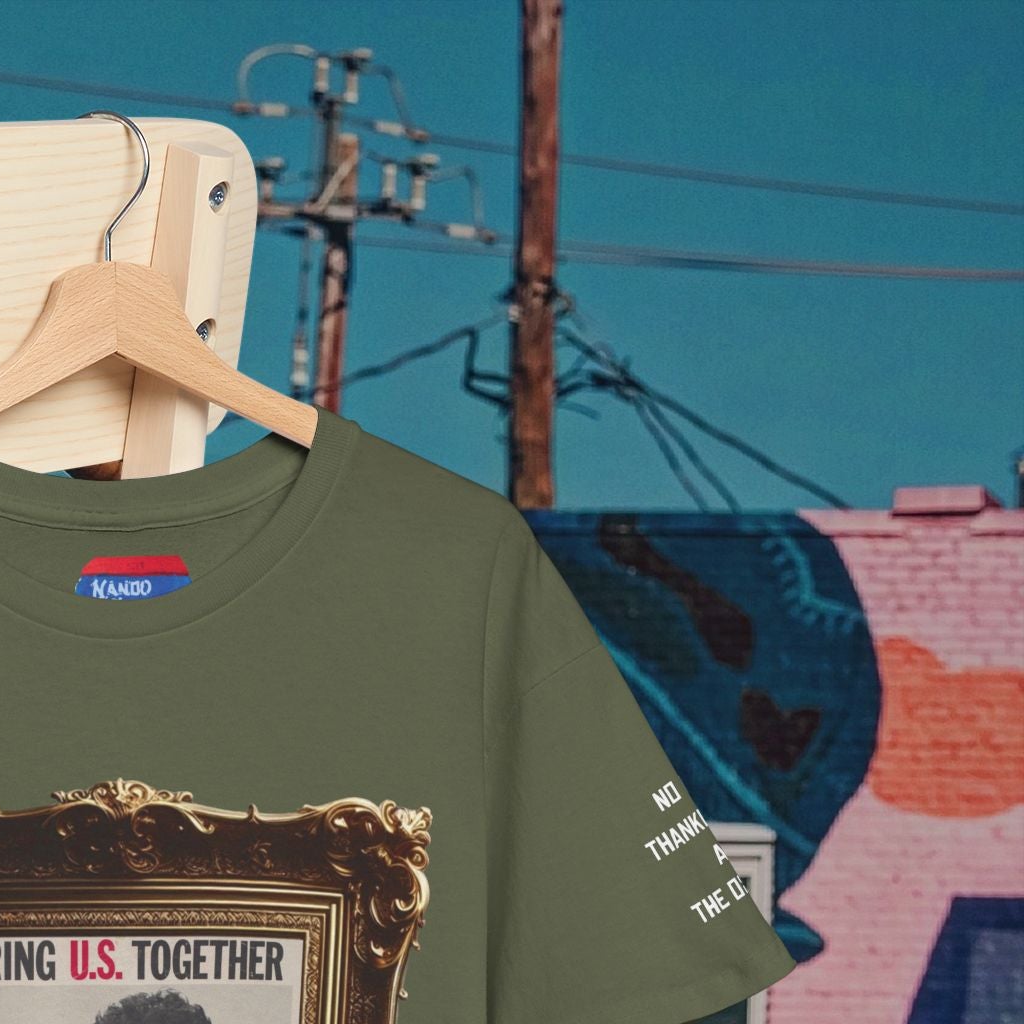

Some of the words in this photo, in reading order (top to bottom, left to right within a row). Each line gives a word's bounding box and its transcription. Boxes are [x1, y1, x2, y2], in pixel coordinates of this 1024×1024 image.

[90, 579, 152, 599] NANDO
[651, 780, 682, 812] NO
[644, 808, 708, 861] THANK
[690, 888, 731, 923] THE
[70, 939, 123, 980] U.S.
[131, 939, 284, 981] TOGETHER
